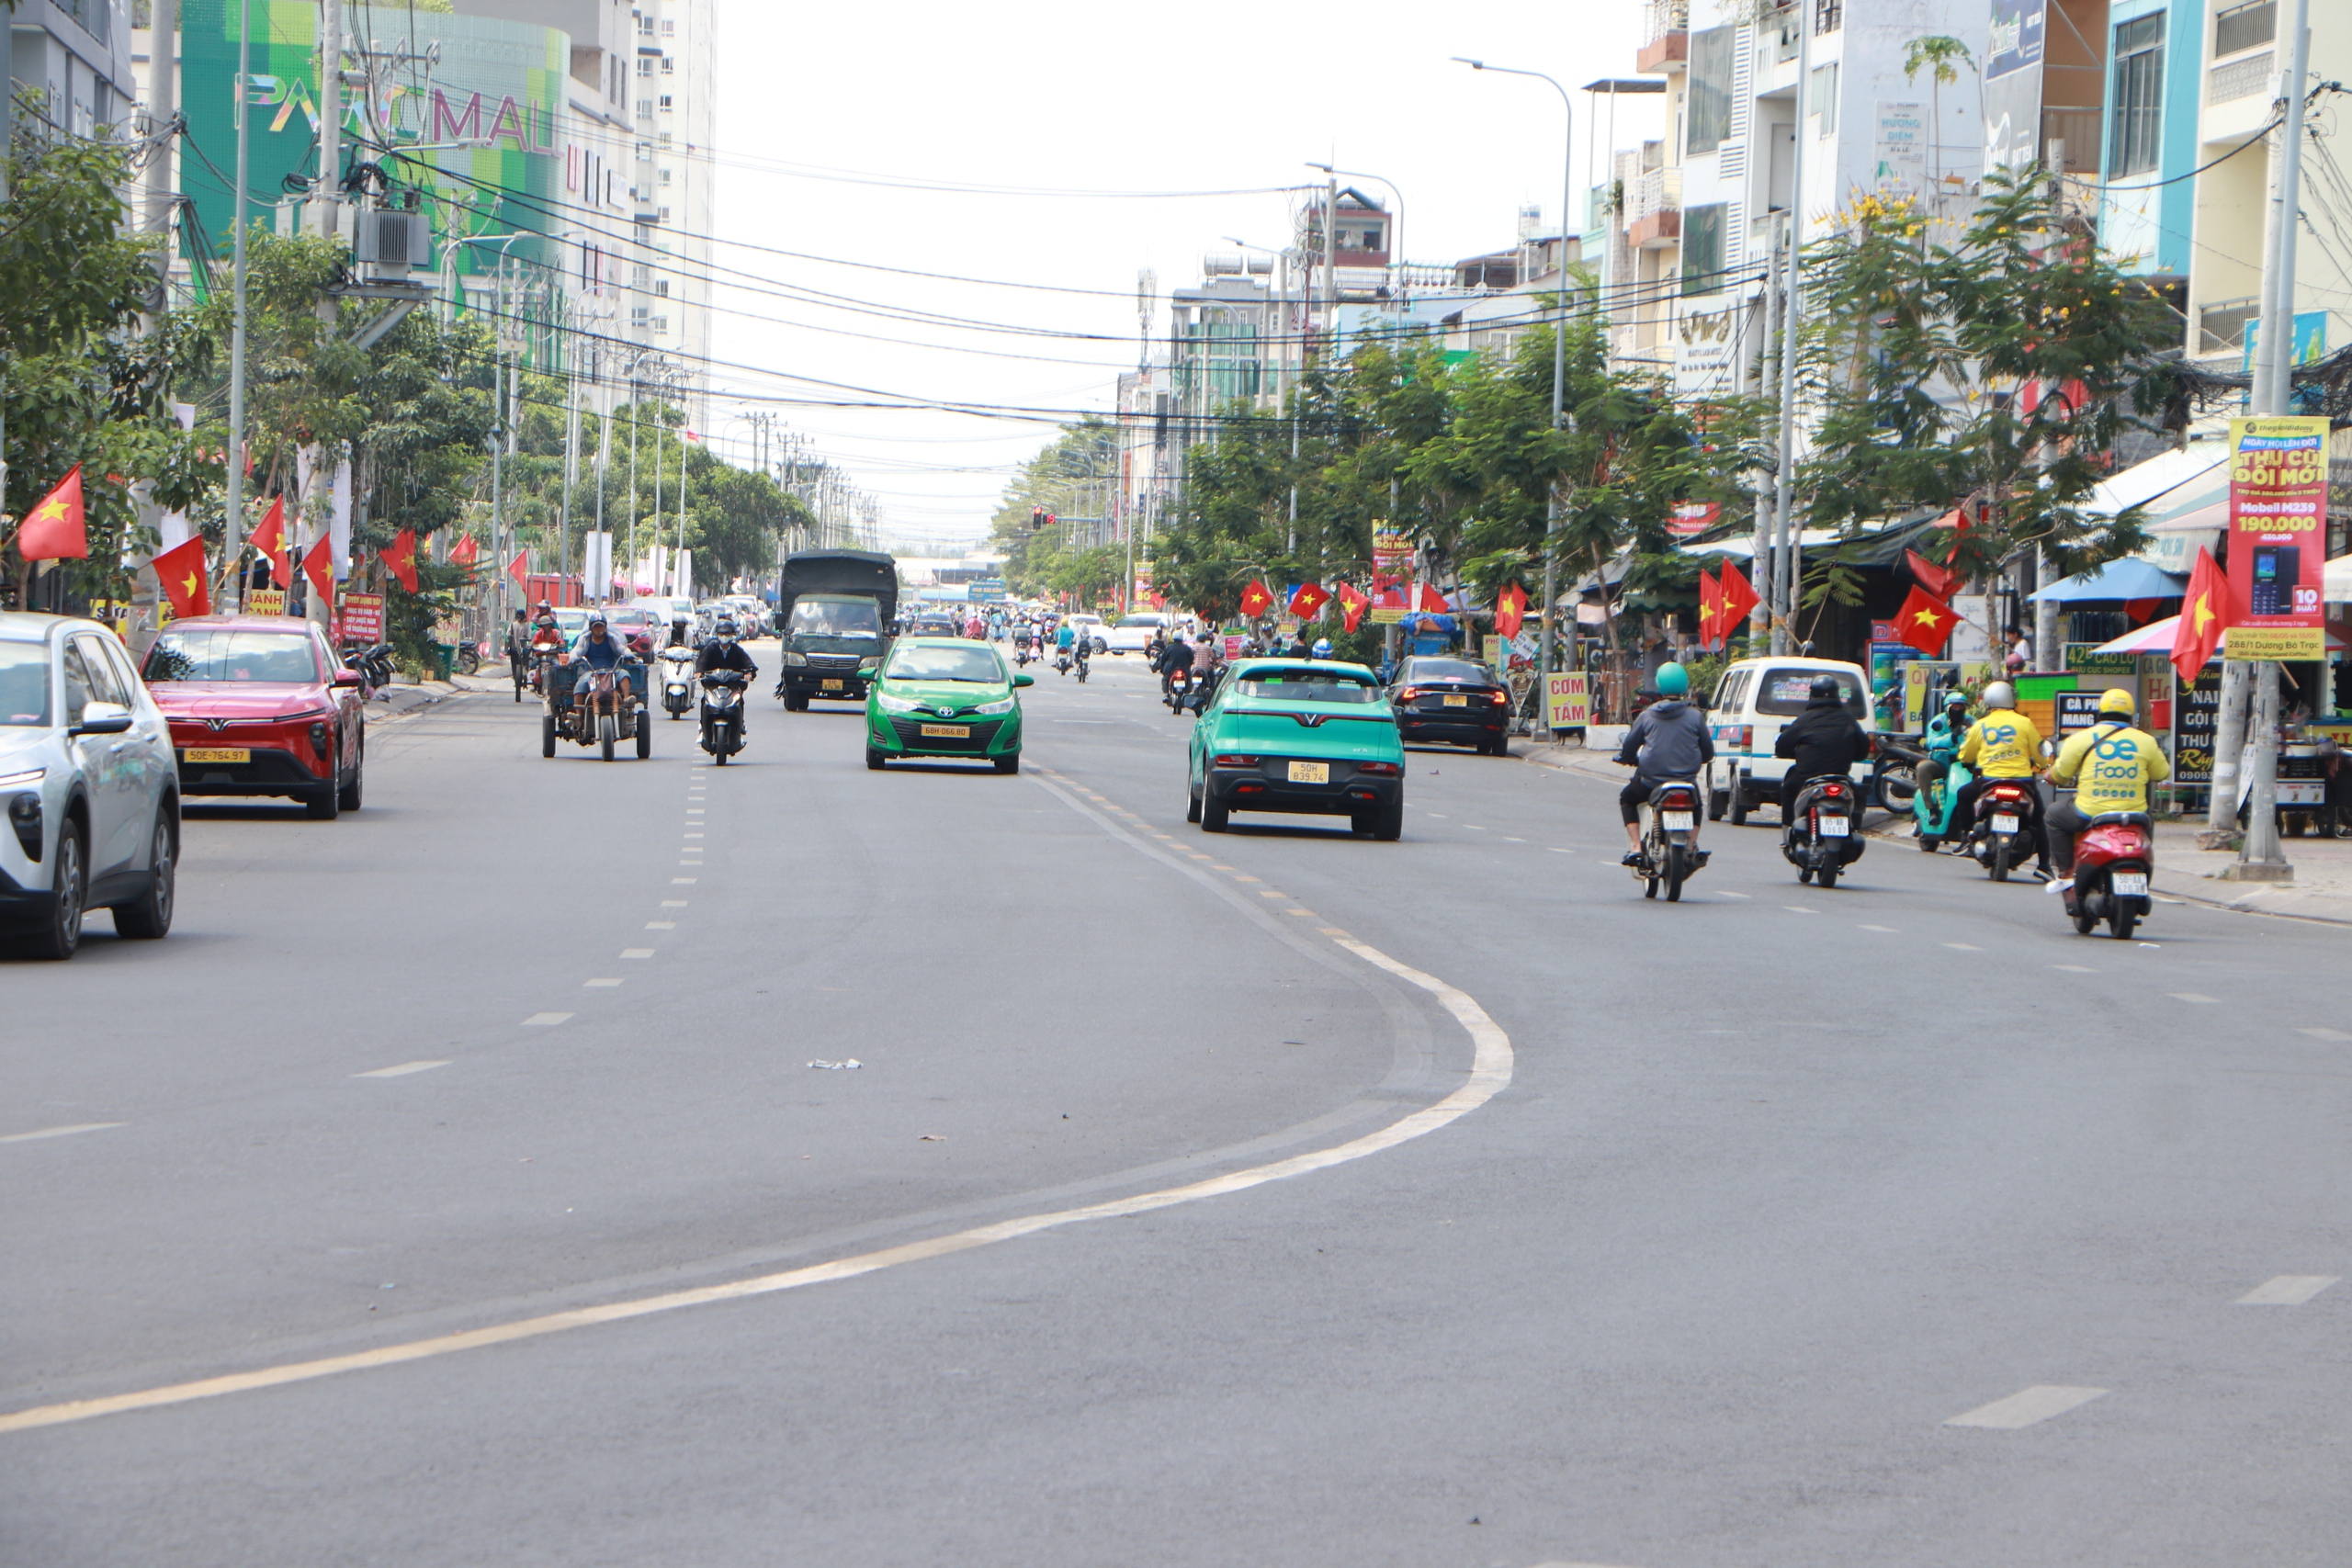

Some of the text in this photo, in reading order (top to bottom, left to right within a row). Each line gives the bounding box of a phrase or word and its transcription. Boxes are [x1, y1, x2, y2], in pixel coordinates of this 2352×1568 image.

[234, 73, 566, 158] PAC MALL
[2243, 436, 2267, 447] NGÀY
[2283, 438, 2300, 447] LÊN
[2278, 465, 2324, 487] MỚI
[2240, 502, 2280, 513] Mobell
[2282, 502, 2316, 513] M239
[2238, 516, 2317, 533] 190.000
[2296, 589, 2318, 604] 10
[2229, 640, 2254, 649] 288/1
[2103, 666, 2132, 675] SHOPEE
[1551, 677, 1585, 695] CƠM
[2067, 695, 2082, 710] CÀ
[2085, 697, 2099, 710] PH
[2192, 690, 2220, 704] NAI
[1554, 700, 1586, 722] TẤM
[2063, 714, 2095, 726] MANG
[2186, 710, 2209, 728] GỘI
[1982, 721, 2017, 746] be
[2181, 732, 2211, 748] THƯ
[2093, 732, 2138, 761] be
[189, 750, 244, 761] 50E-764.97
[1300, 763, 1317, 773] 50H
[2095, 761, 2139, 779] Food
[1293, 773, 1324, 782] 839.74
